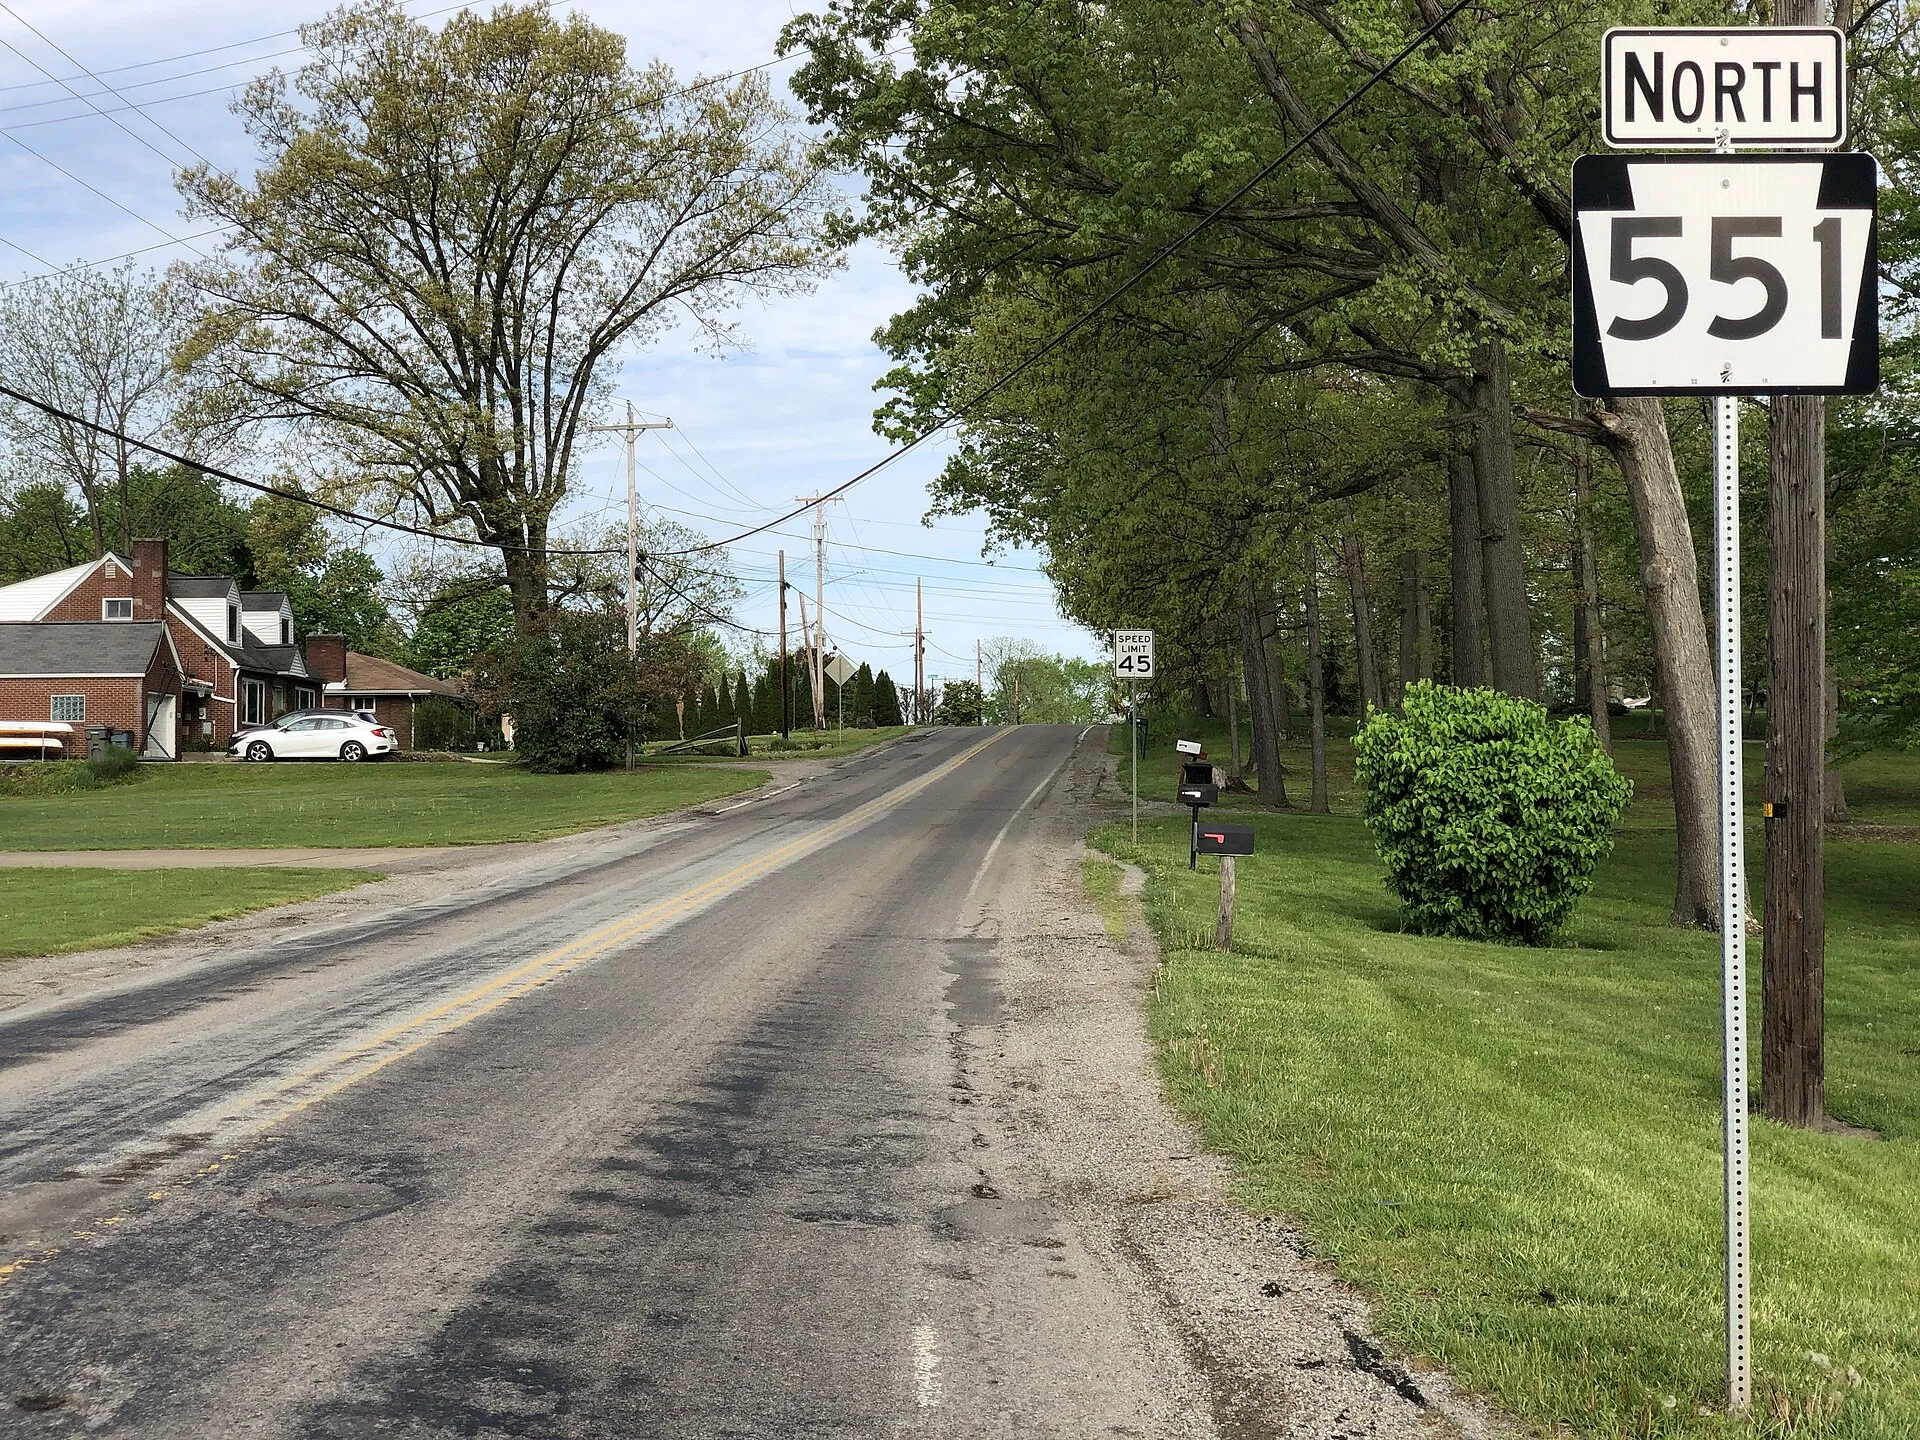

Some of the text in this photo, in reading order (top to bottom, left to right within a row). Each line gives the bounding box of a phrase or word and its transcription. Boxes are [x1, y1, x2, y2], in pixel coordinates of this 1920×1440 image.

[1624, 51, 1823, 124] NORTH
[1606, 216, 1843, 342] 551
[1118, 635, 1151, 643] SPEED
[1121, 645, 1147, 653] LIMIT
[1118, 655, 1151, 673] 45
